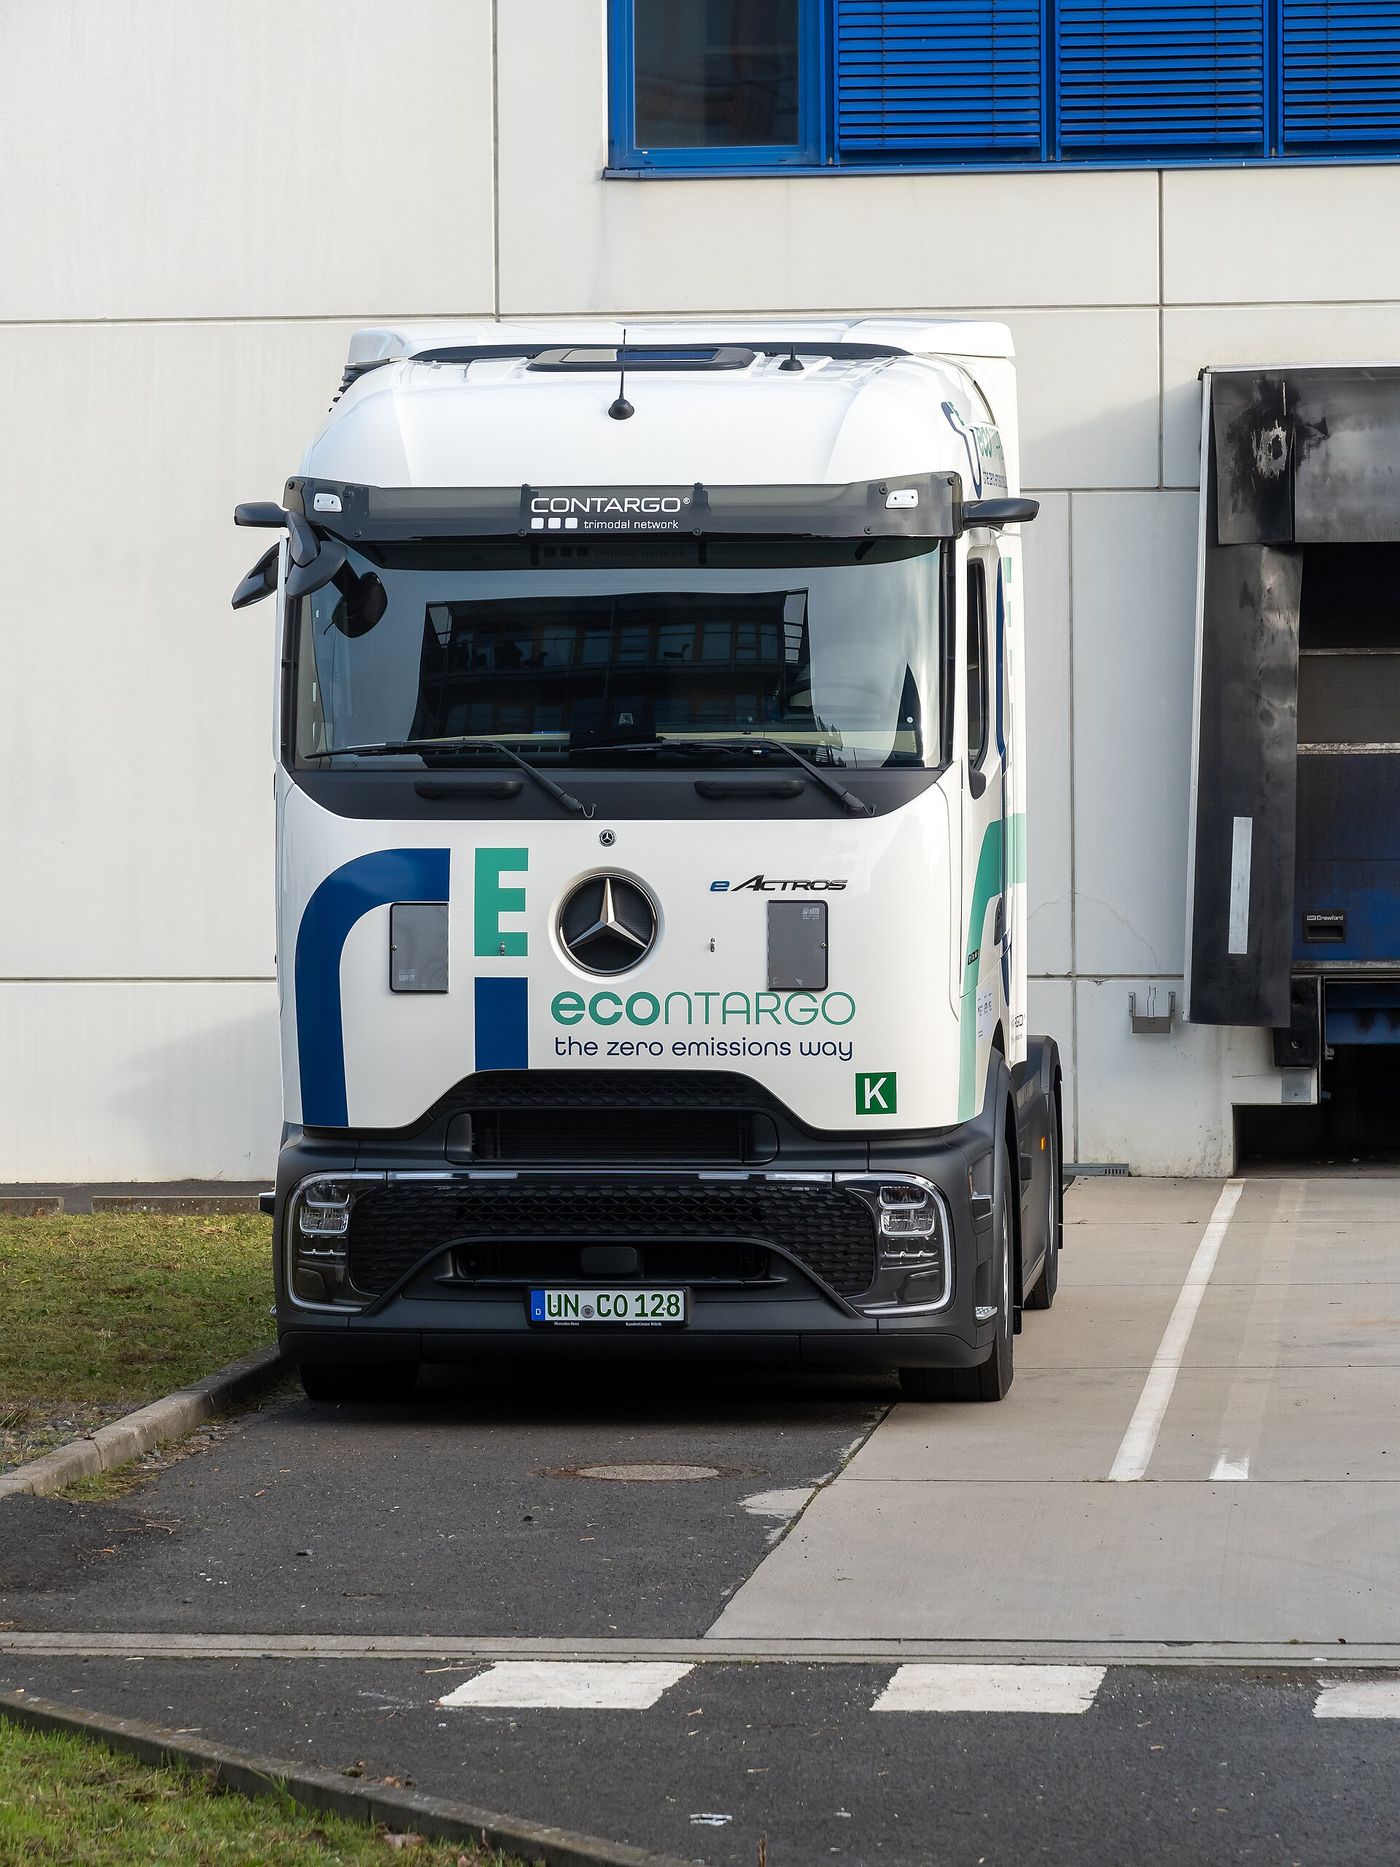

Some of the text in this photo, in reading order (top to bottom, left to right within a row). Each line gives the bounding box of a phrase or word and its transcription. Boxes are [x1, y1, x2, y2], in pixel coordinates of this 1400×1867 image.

[584, 519, 679, 529] trimodal network
[554, 1036, 854, 1061] the zero emissions way
[864, 1077, 888, 1110] K
[547, 1293, 579, 1318] UN
[634, 1293, 681, 1318] 128
